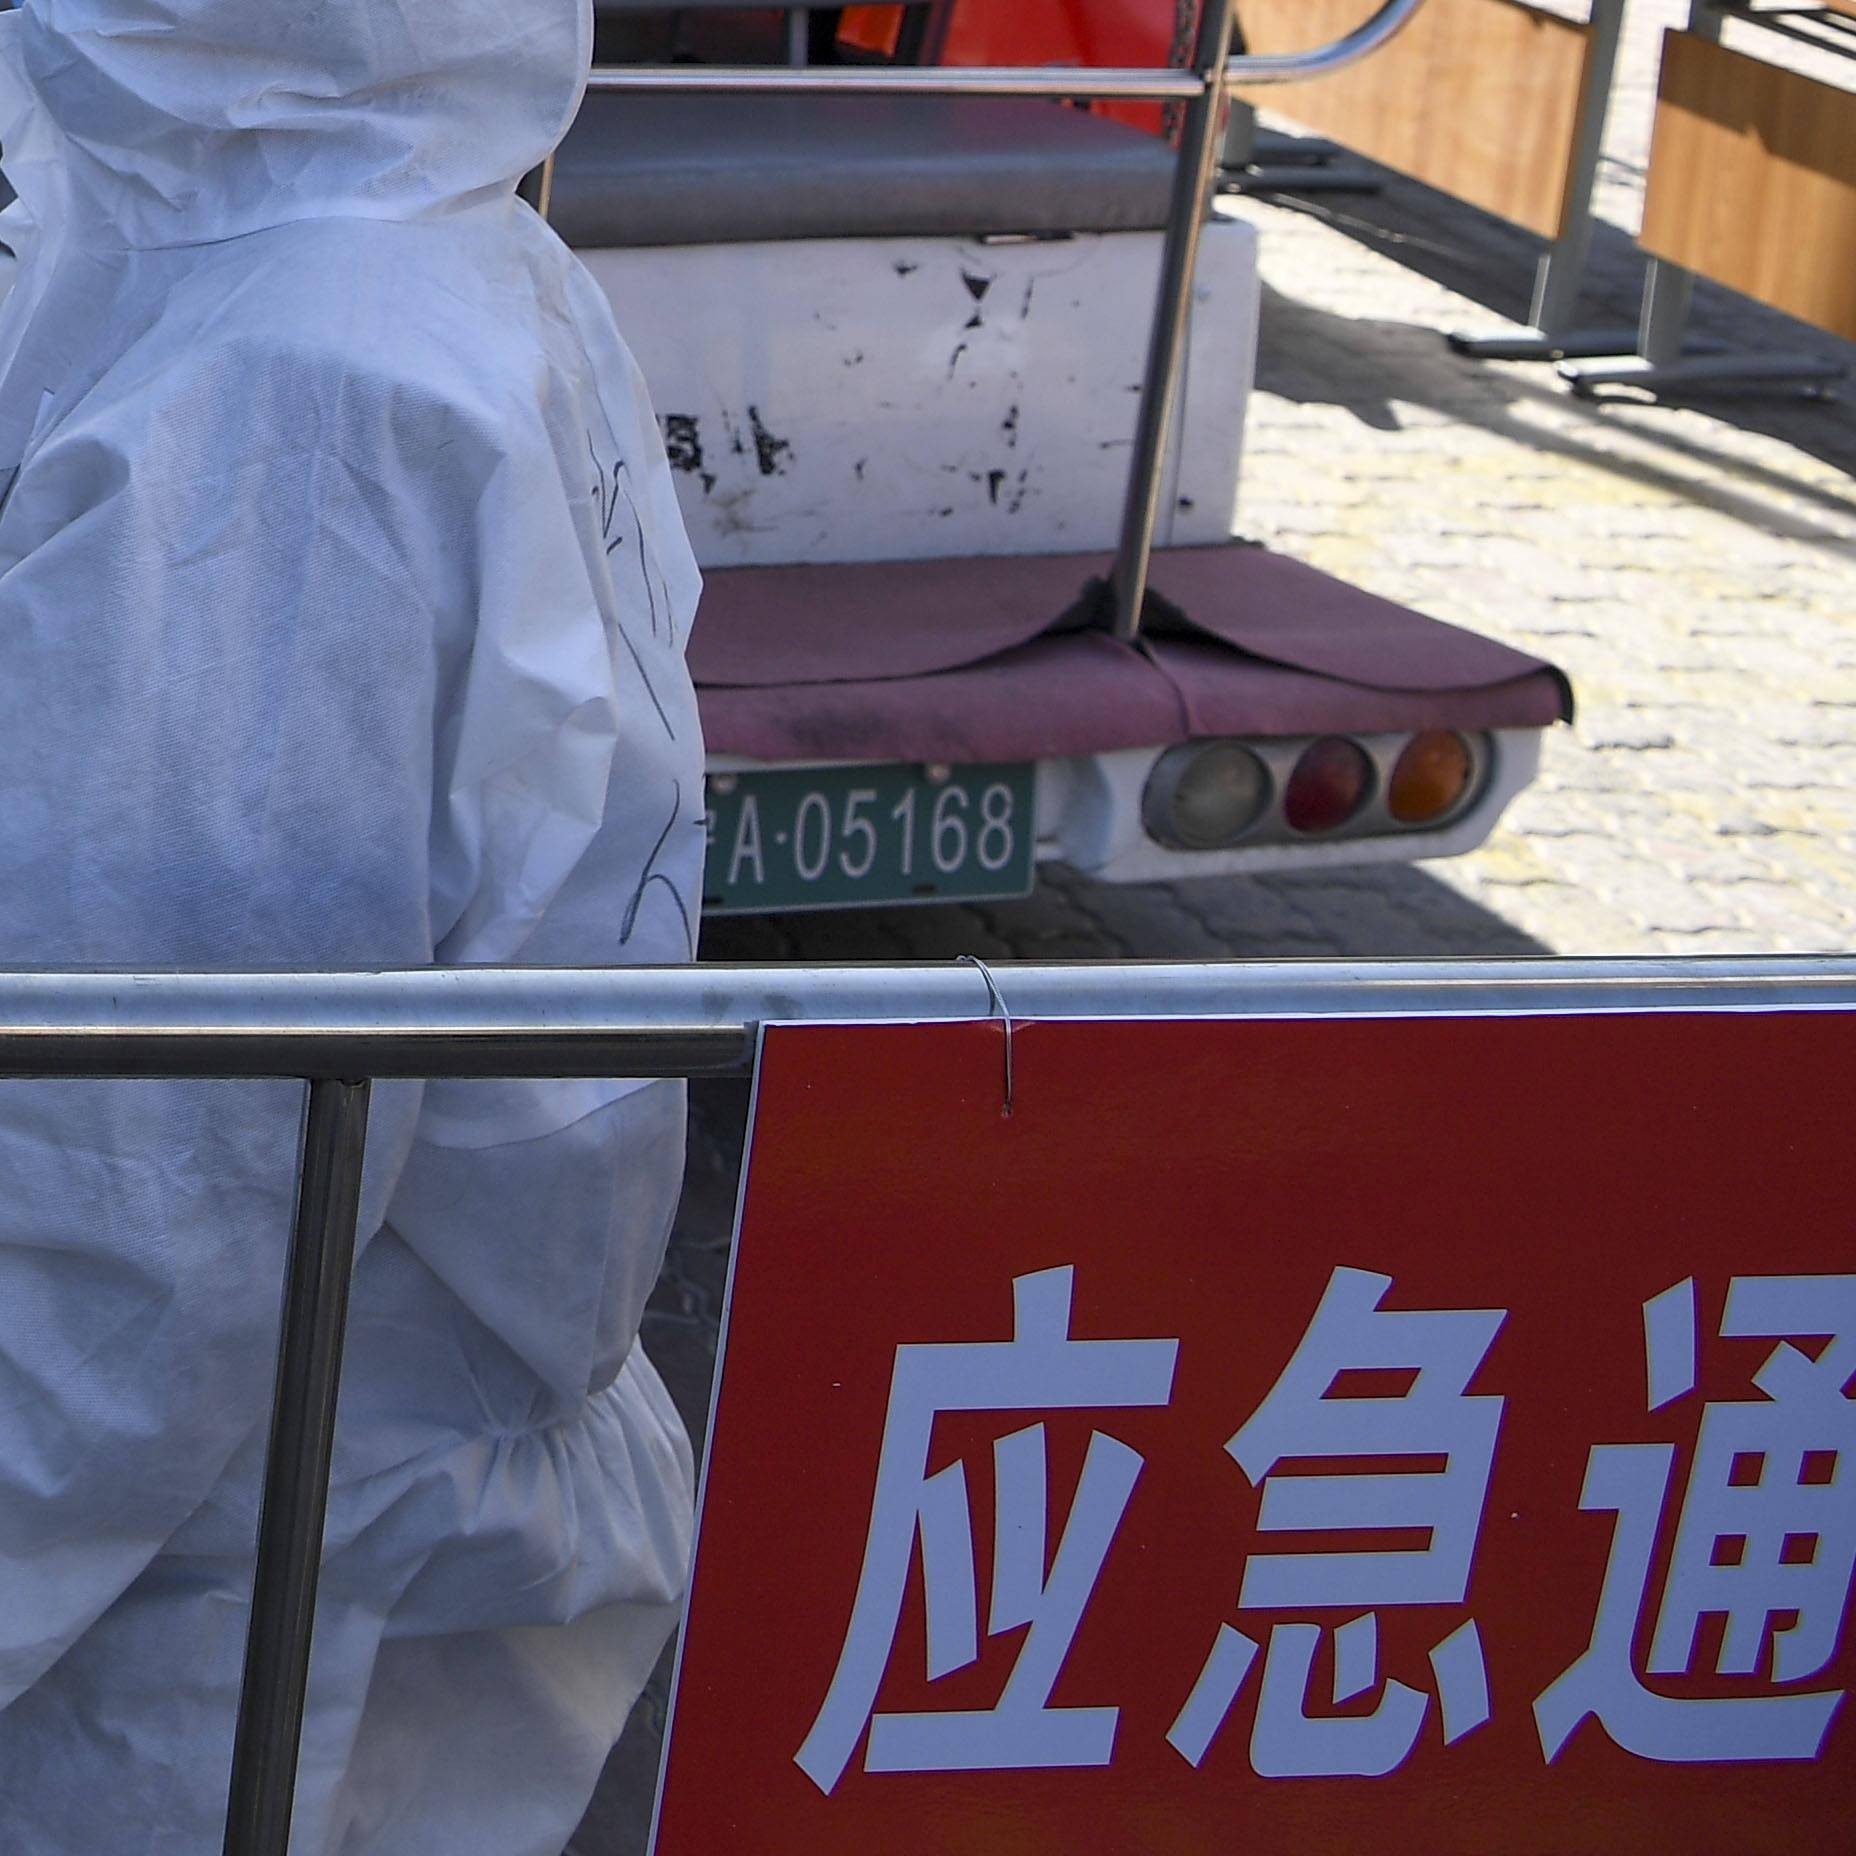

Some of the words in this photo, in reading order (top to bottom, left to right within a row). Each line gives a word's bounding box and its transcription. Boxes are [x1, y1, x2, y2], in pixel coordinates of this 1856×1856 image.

[702, 782, 1015, 887] A·05168
[793, 1261, 1856, 1796] 应急通
